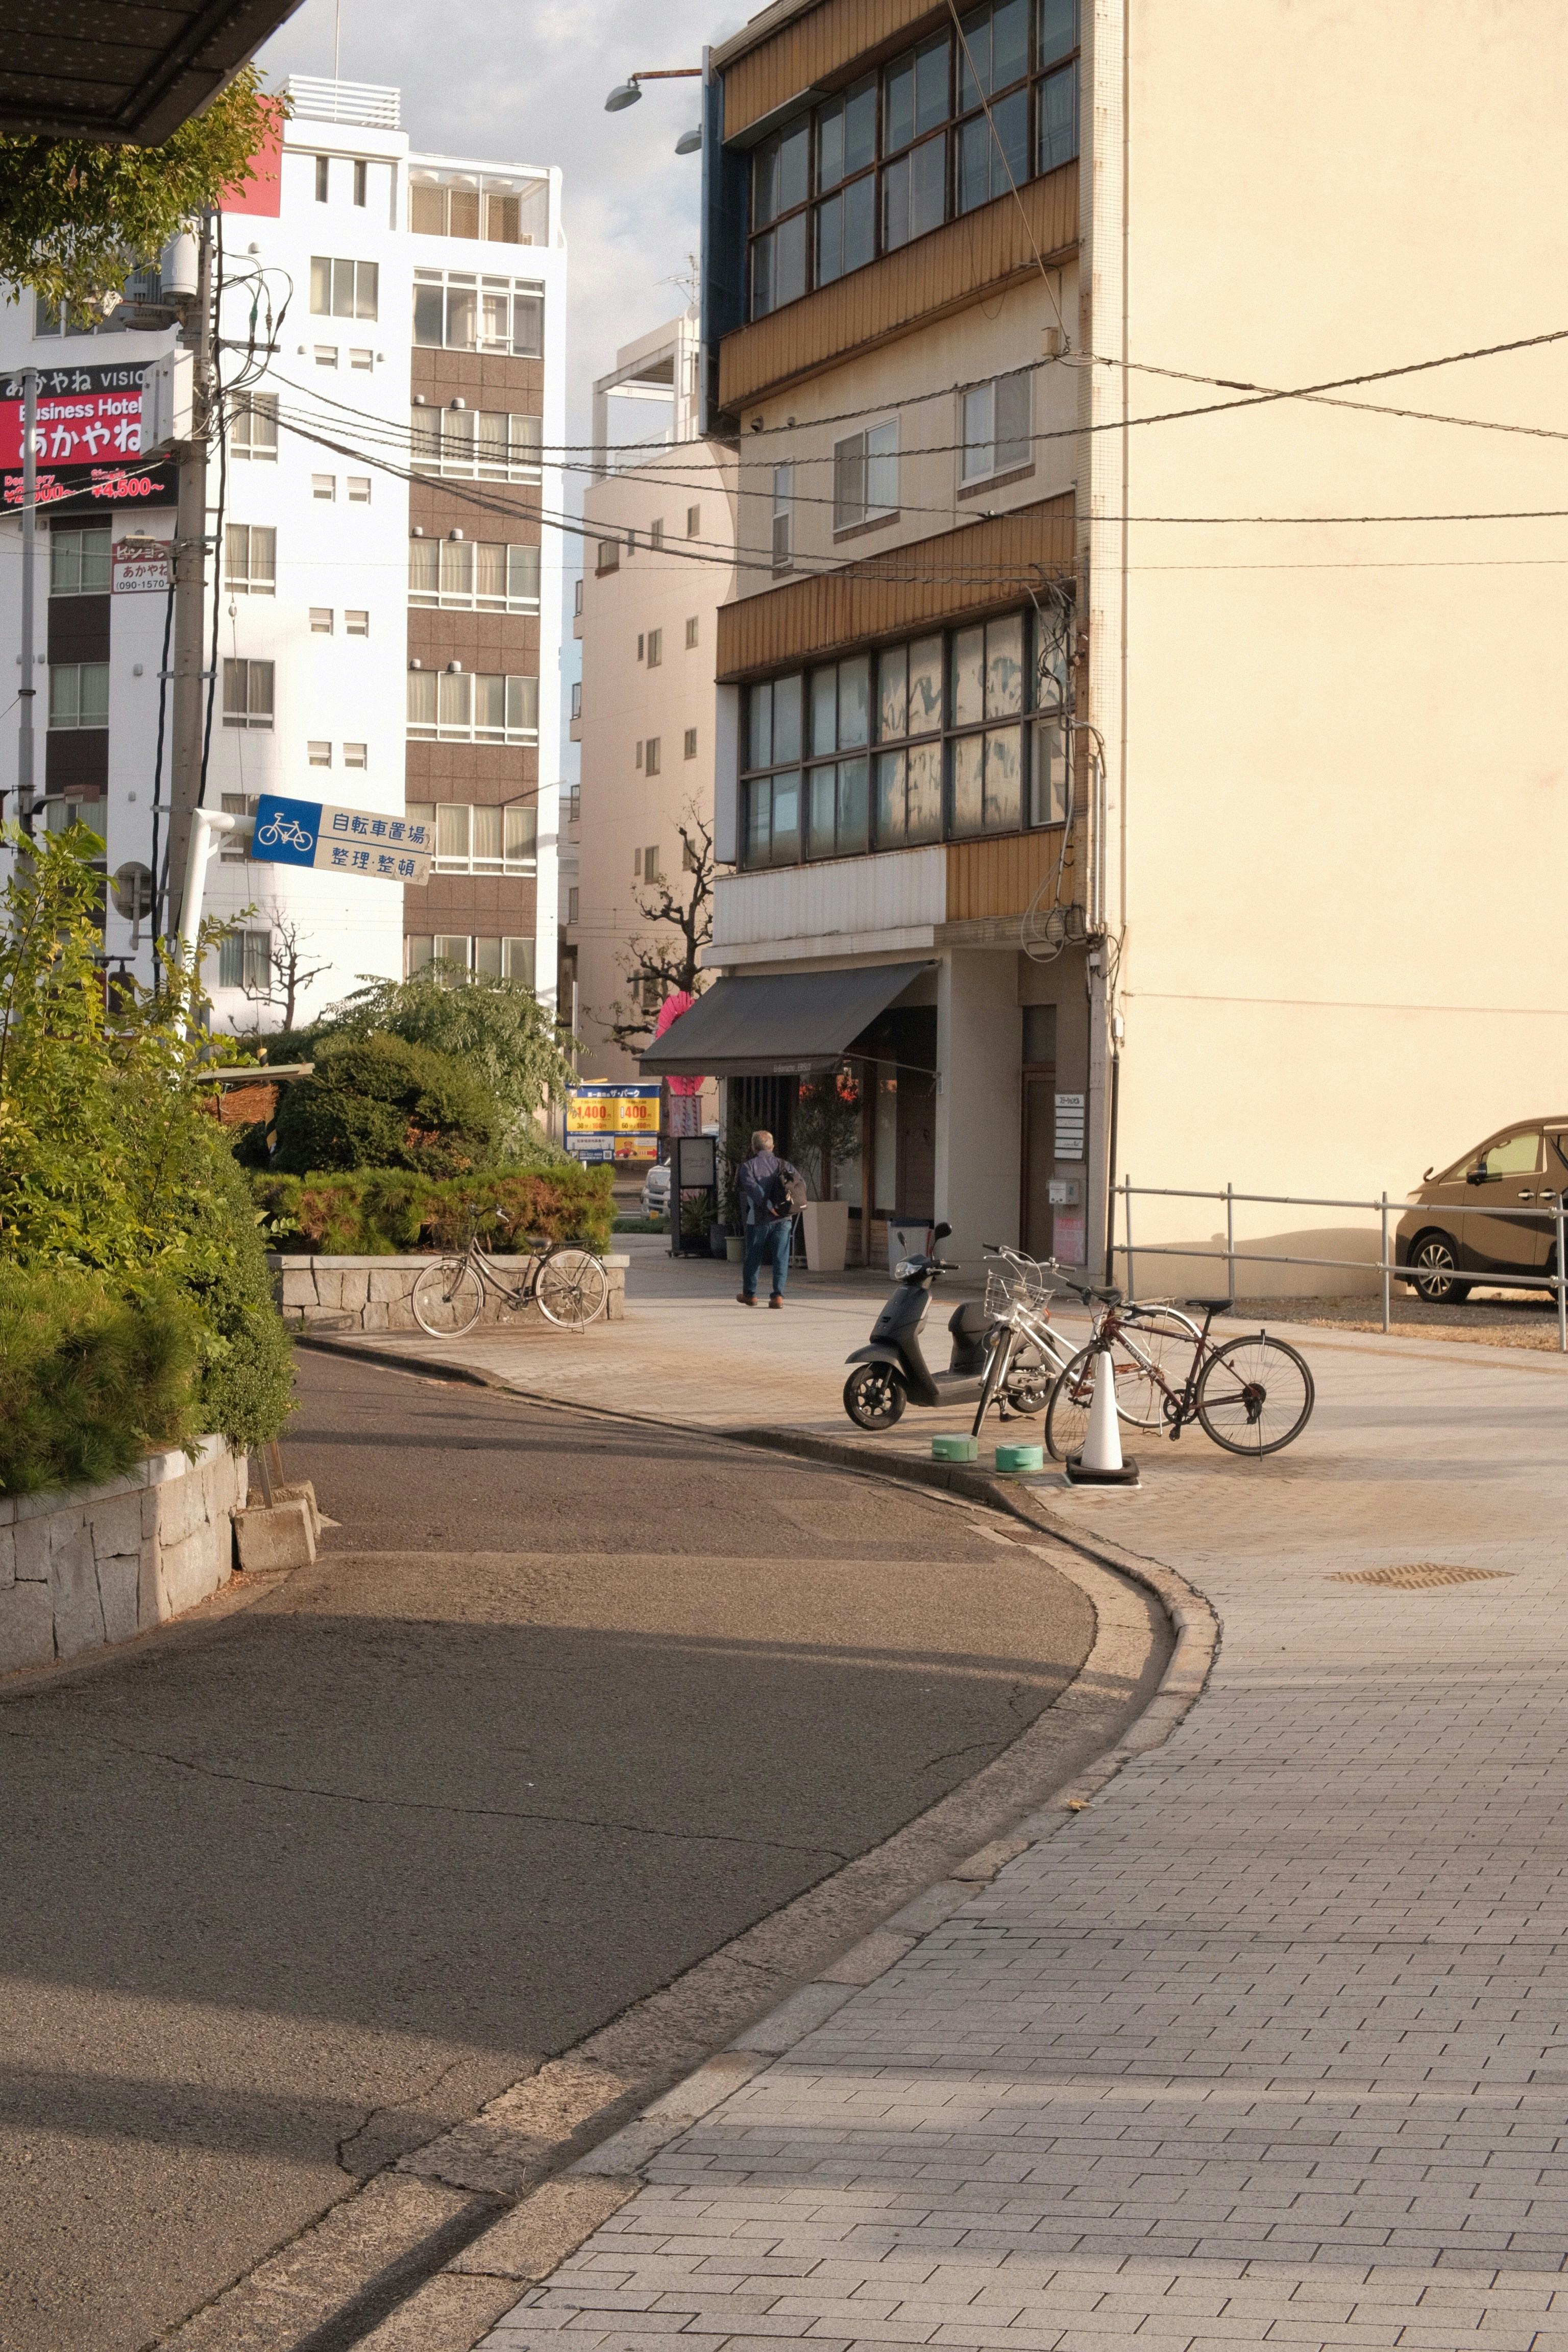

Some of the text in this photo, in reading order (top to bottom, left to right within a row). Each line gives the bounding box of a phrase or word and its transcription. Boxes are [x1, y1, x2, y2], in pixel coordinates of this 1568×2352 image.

[333, 814, 425, 844] 自転車置場
[331, 847, 415, 877] 整理・整頓
[1124, 1342, 1160, 1379] CHEVROLET
